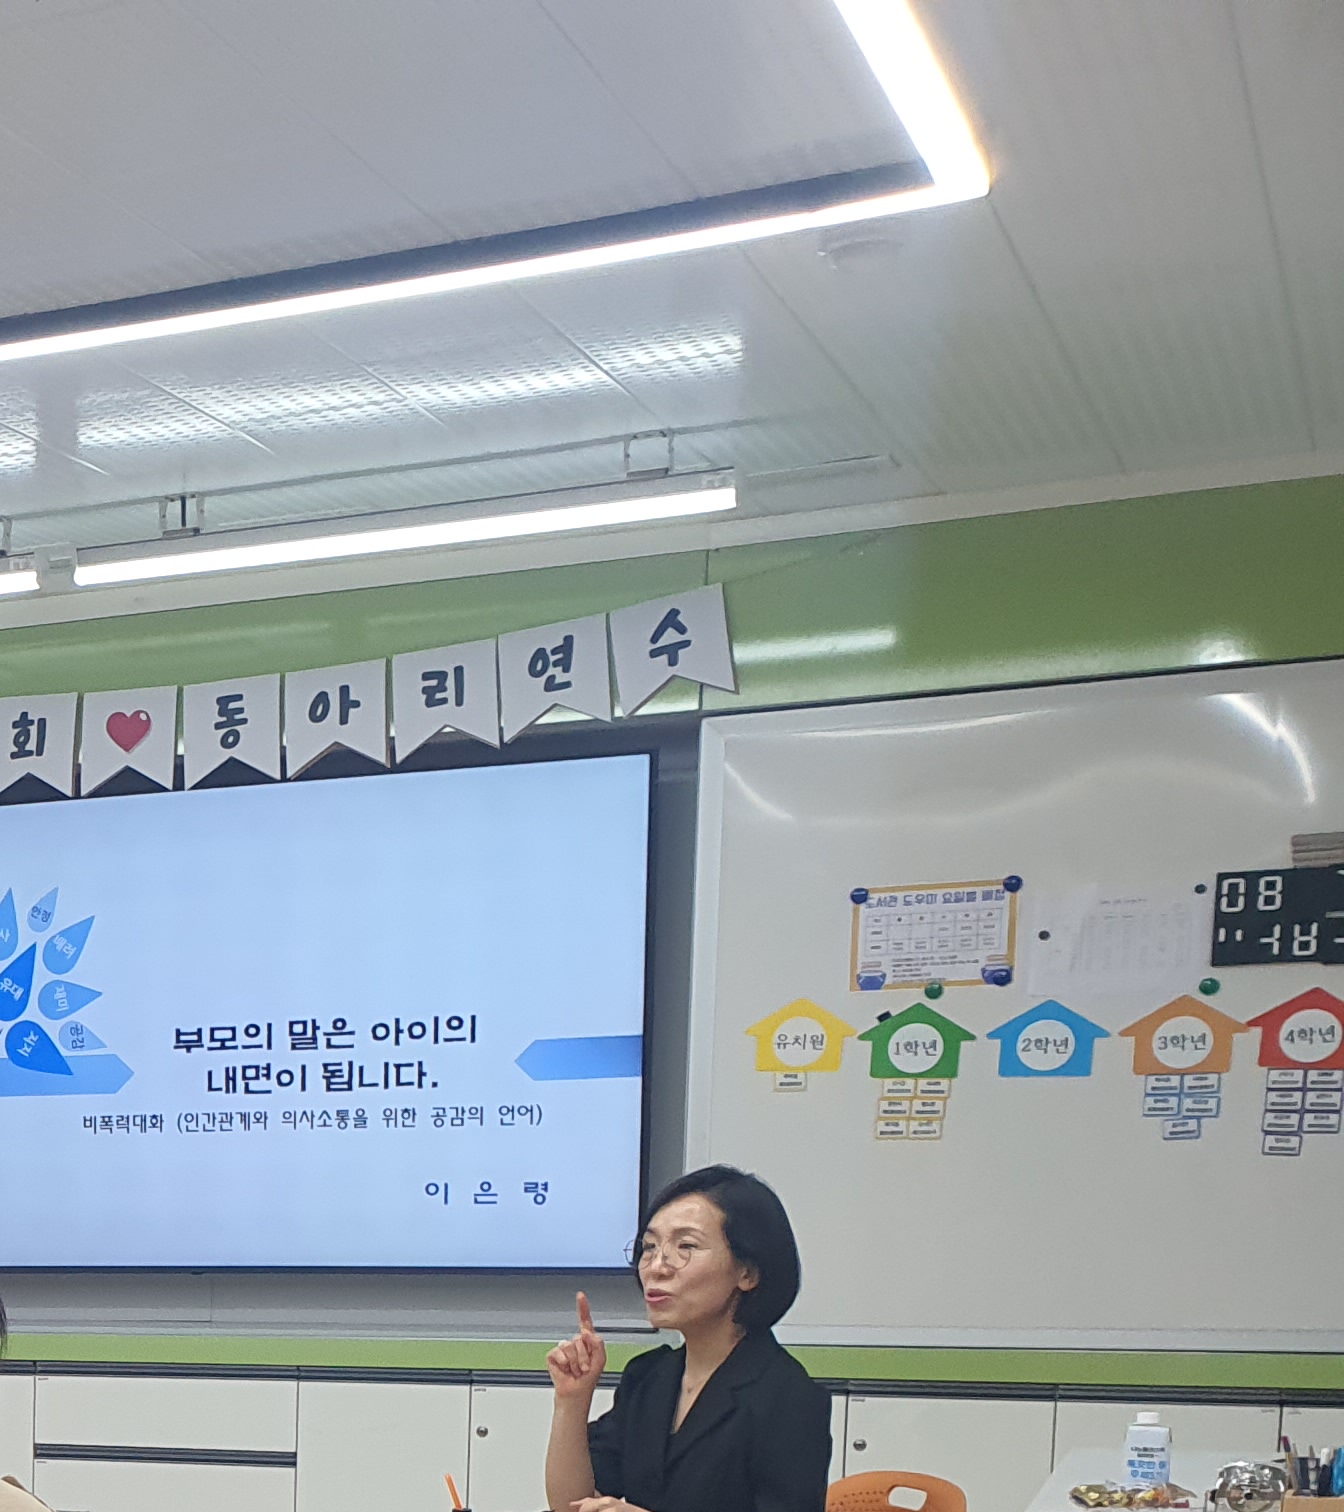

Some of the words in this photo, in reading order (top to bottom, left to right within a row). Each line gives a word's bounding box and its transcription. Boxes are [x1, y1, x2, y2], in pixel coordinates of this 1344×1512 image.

[0, 977, 25, 1001] 유대
[16, 1031, 41, 1057] 지지
[70, 1023, 85, 1049] 공감
[173, 1022, 273, 1053] 부모의
[288, 1018, 356, 1051] 말은
[371, 1014, 477, 1046] 아이의
[775, 1033, 825, 1051] 유치원
[1021, 1036, 1069, 1055] 2학년
[1157, 1032, 1207, 1051] 3학년
[1284, 1025, 1336, 1045] 4학년
[893, 1038, 938, 1057] 1학년
[206, 1063, 307, 1095] 내면이
[322, 1060, 439, 1092] 됩니다.
[82, 1112, 165, 1134] 비폭력대화
[176, 1109, 269, 1134] (인간관계와
[282, 1107, 369, 1131] 의사소통을
[382, 1106, 417, 1129] 위한
[430, 1104, 484, 1128] 공감의
[498, 1103, 543, 1127] 언어)
